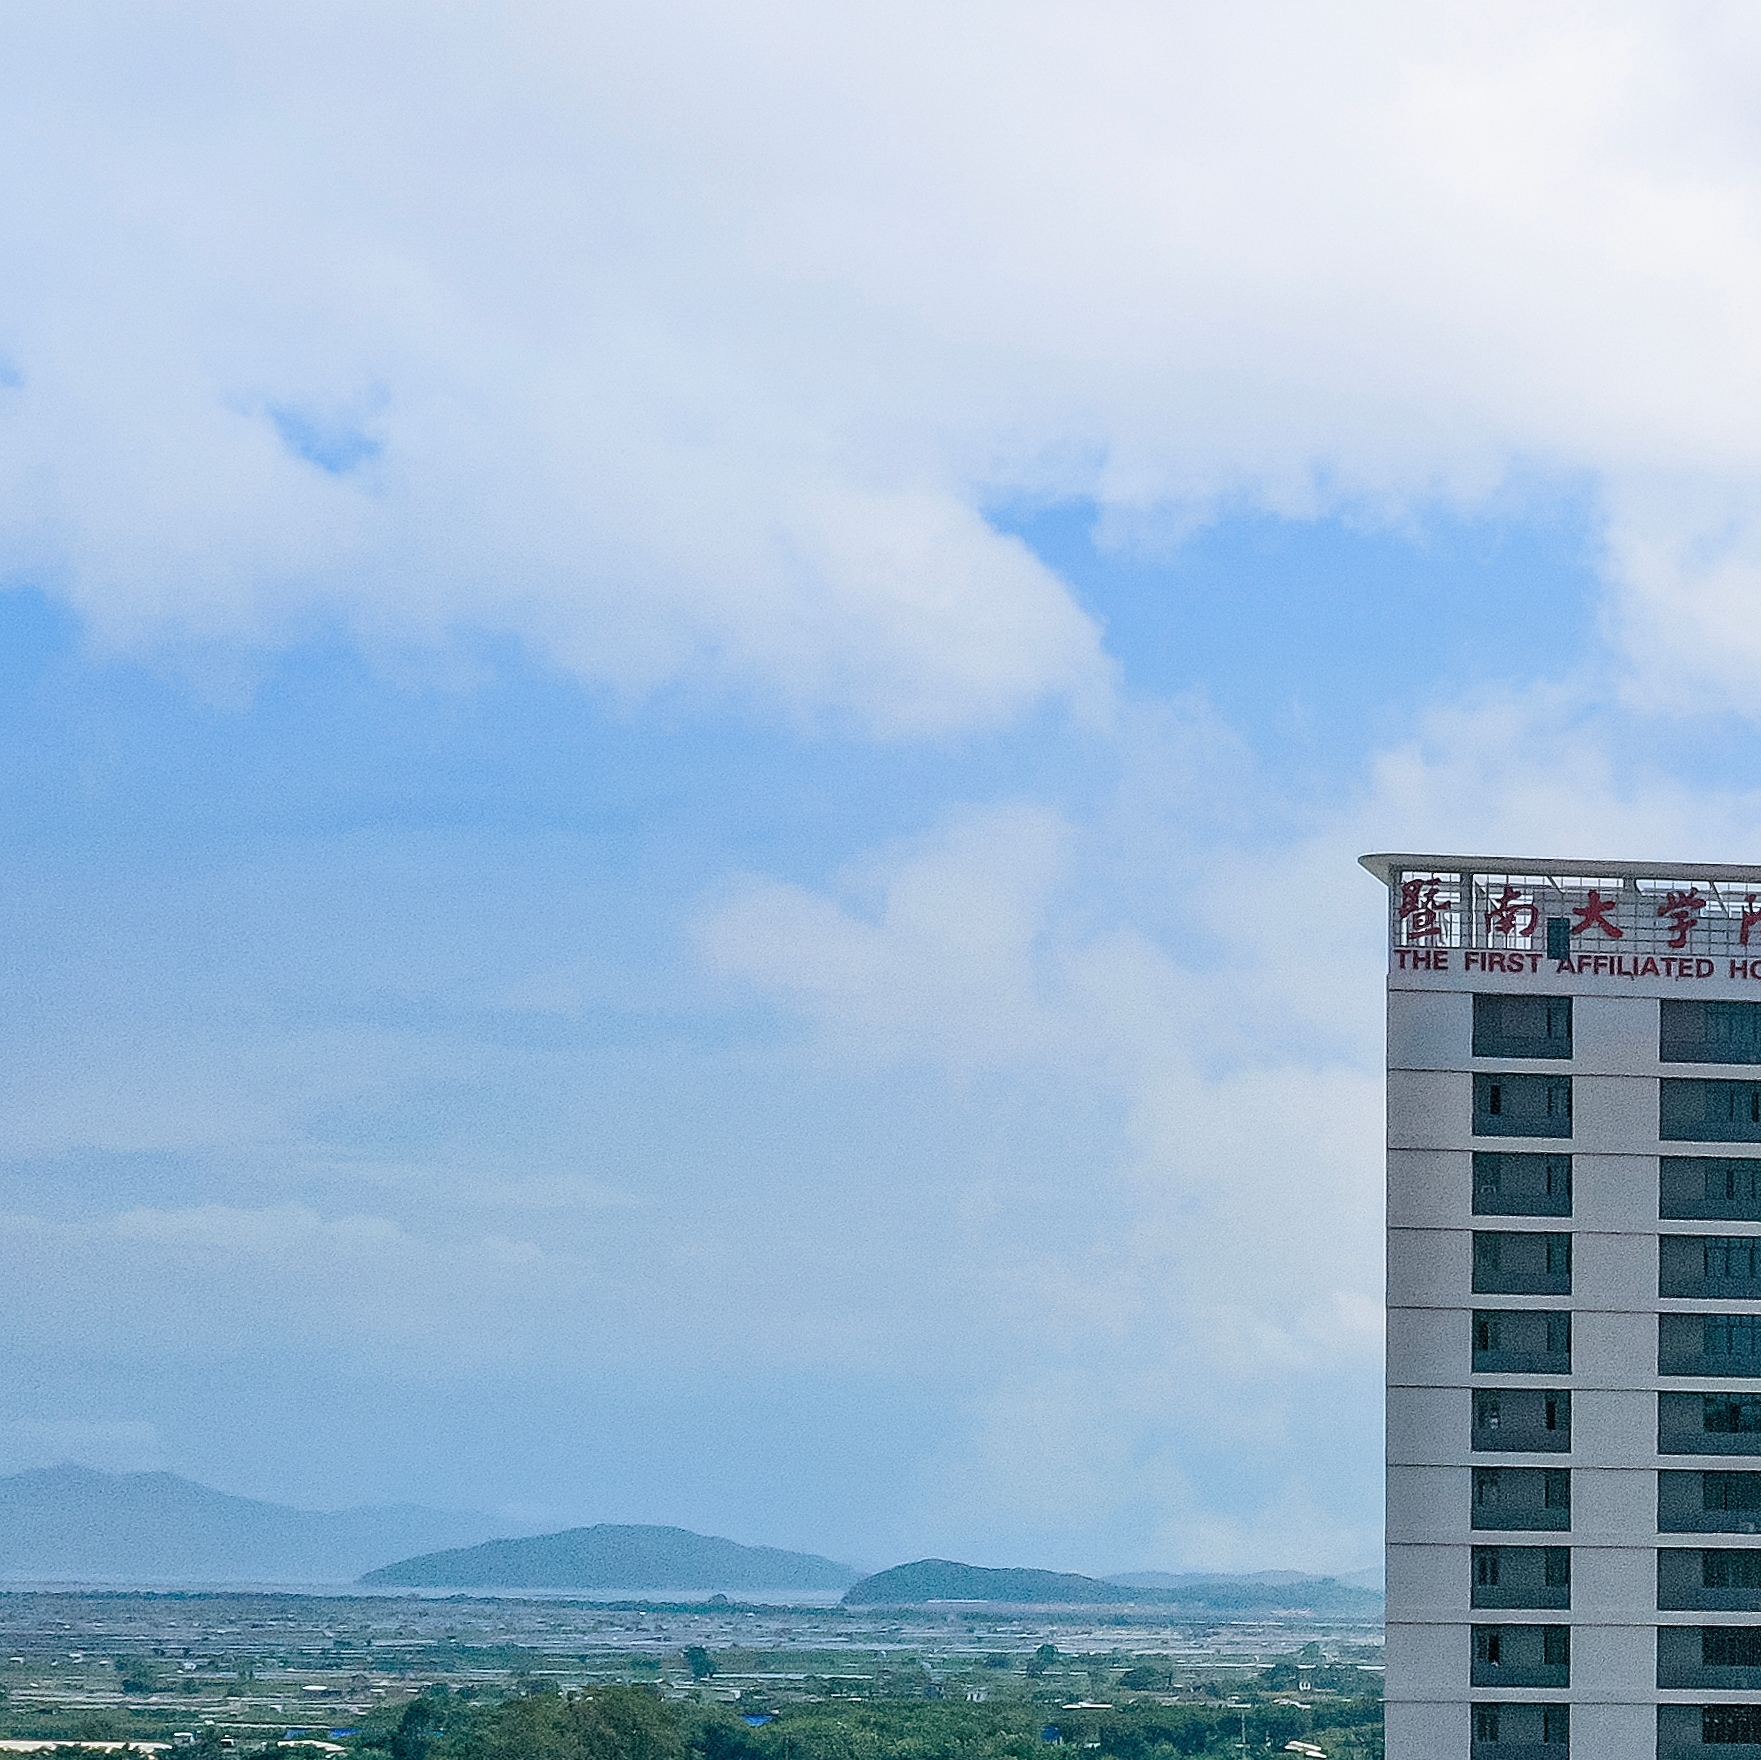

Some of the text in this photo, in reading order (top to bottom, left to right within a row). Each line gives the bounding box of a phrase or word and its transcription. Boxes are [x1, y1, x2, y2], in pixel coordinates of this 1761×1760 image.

[1395, 949, 1448, 972] THE
[1464, 951, 1543, 974] FIRST
[1556, 952, 1715, 979] AFFILIATED
